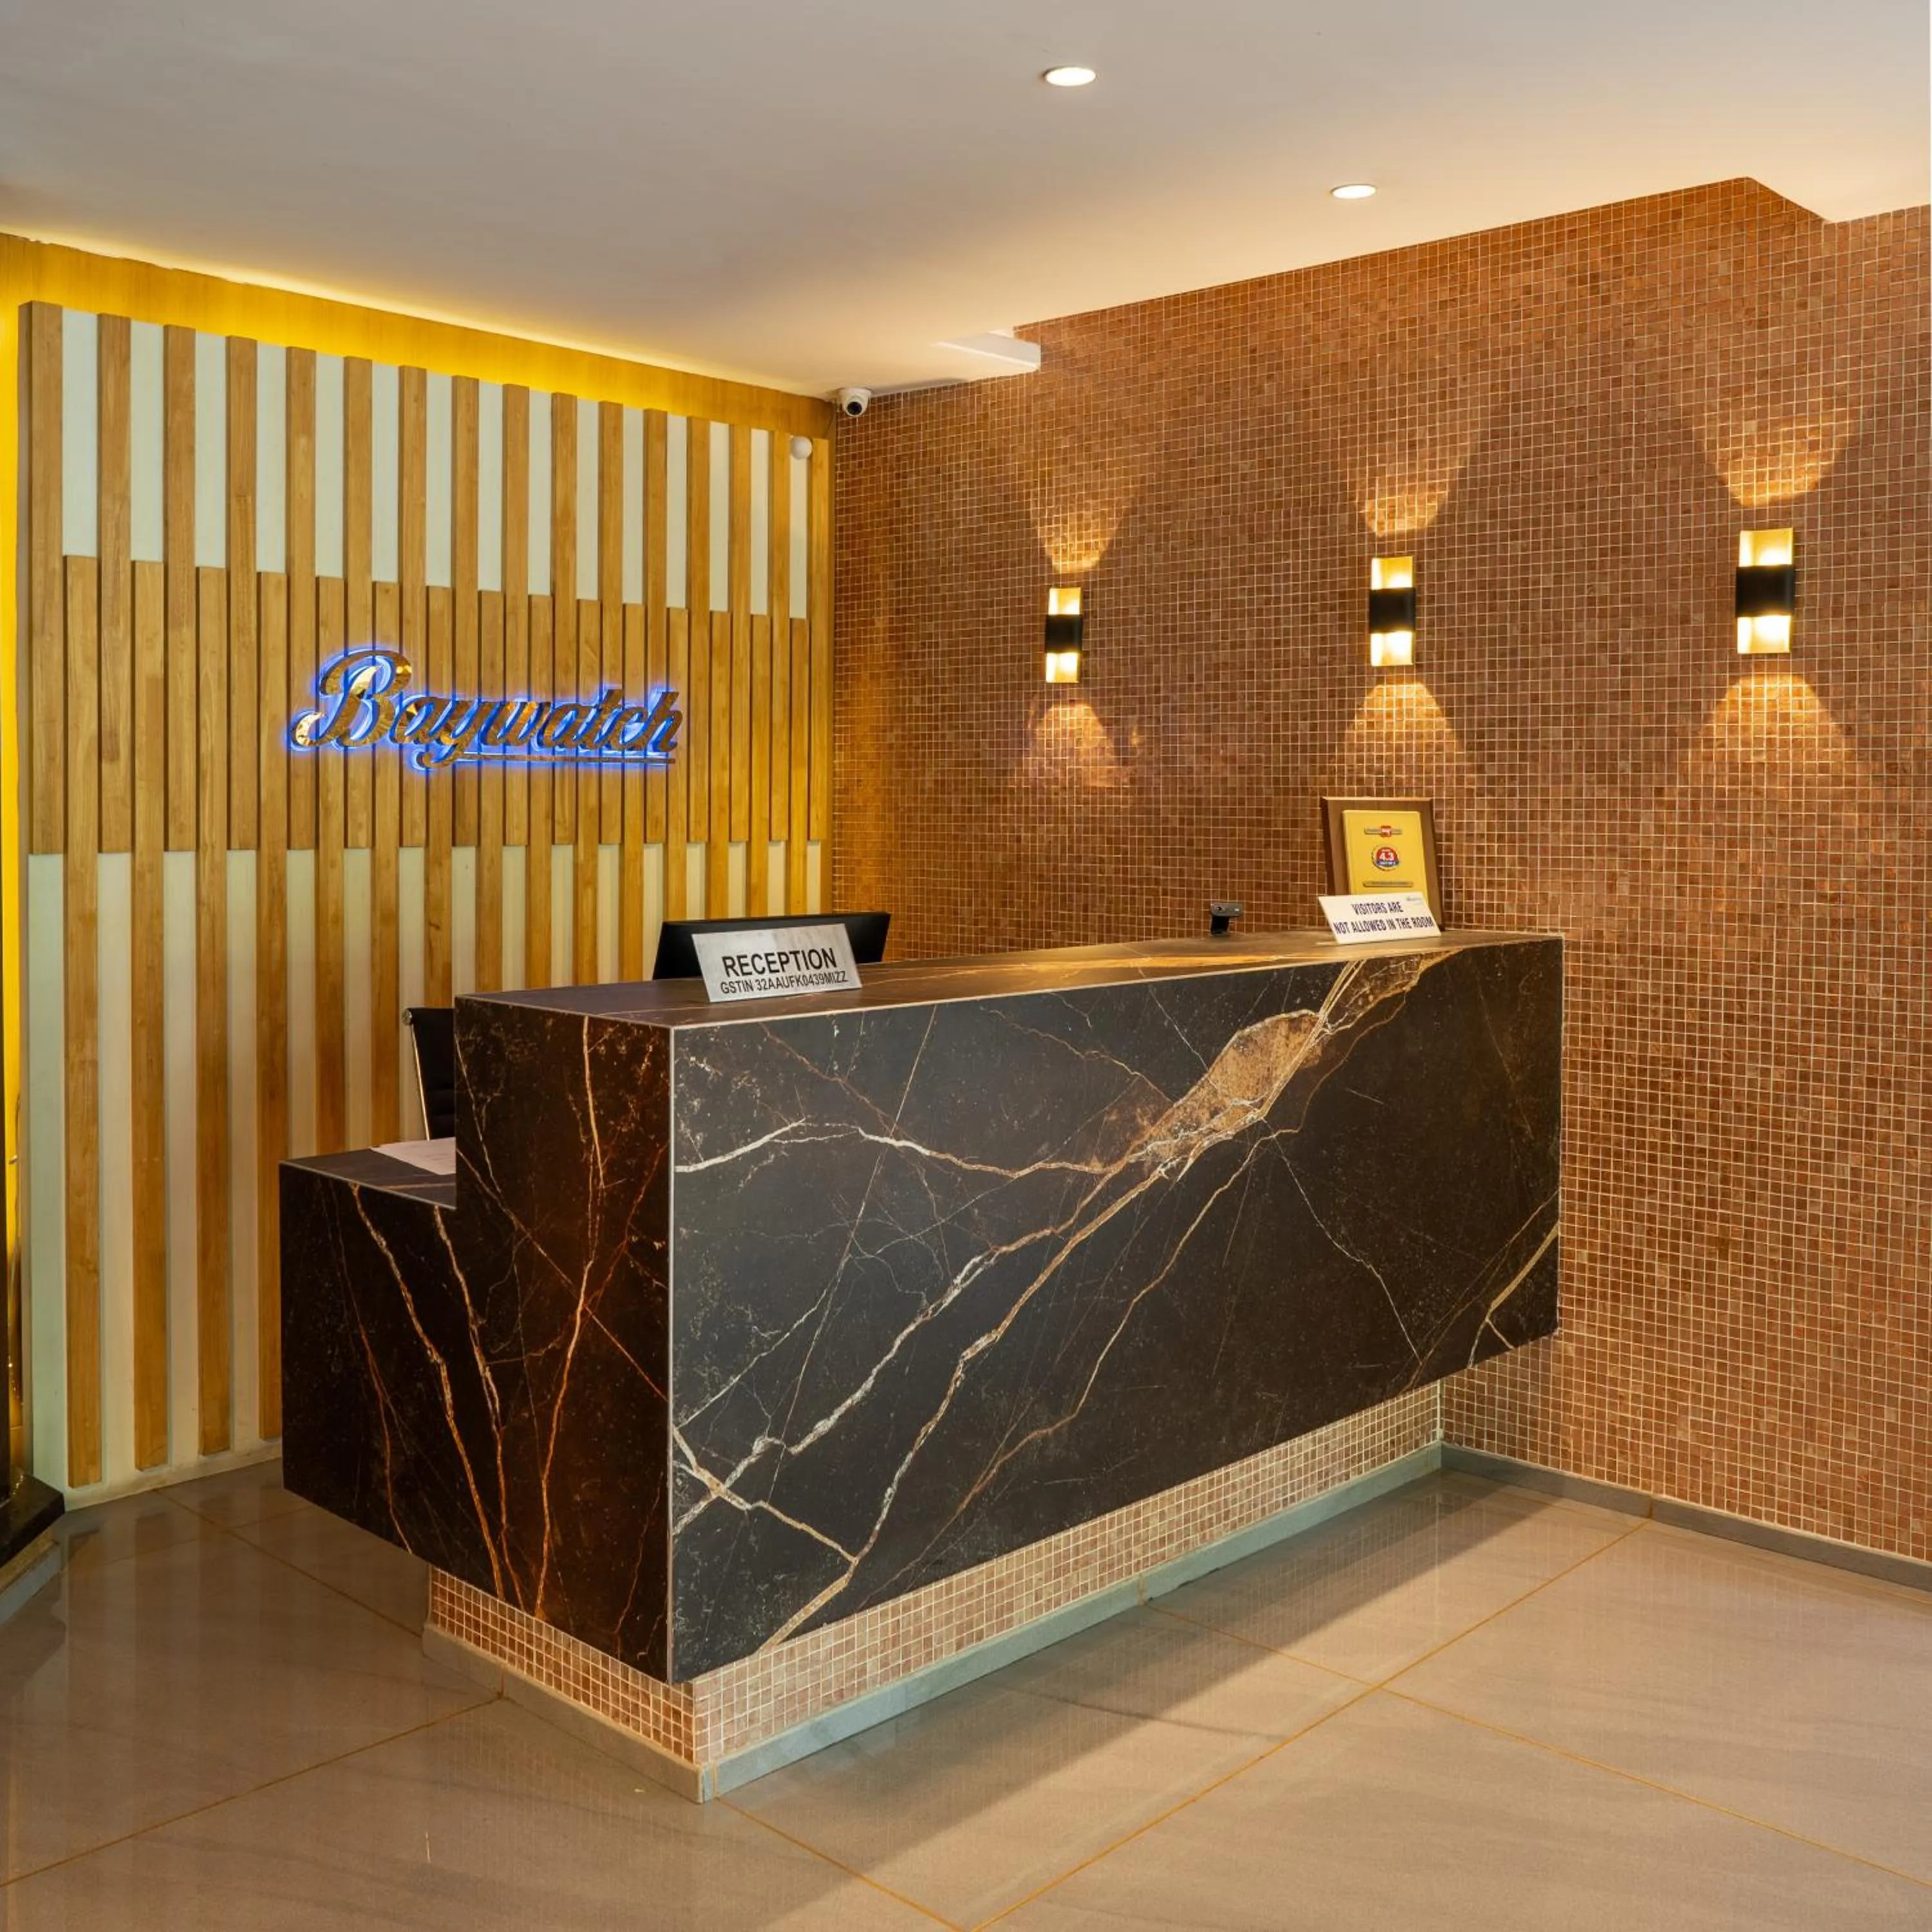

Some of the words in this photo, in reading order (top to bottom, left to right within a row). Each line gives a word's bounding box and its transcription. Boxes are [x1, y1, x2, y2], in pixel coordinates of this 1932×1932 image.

[290, 648, 683, 768] Baywatch
[1351, 902, 1387, 915] VISITORS
[1388, 901, 1404, 913] ARE
[1333, 922, 1350, 934] NOT
[1350, 919, 1387, 933] ALLOWED
[1386, 918, 1397, 930] IN
[1396, 917, 1412, 929] THE
[1411, 916, 1434, 928] ROOM
[721, 947, 837, 978] RECEPTION
[721, 979, 754, 994] GSTIN
